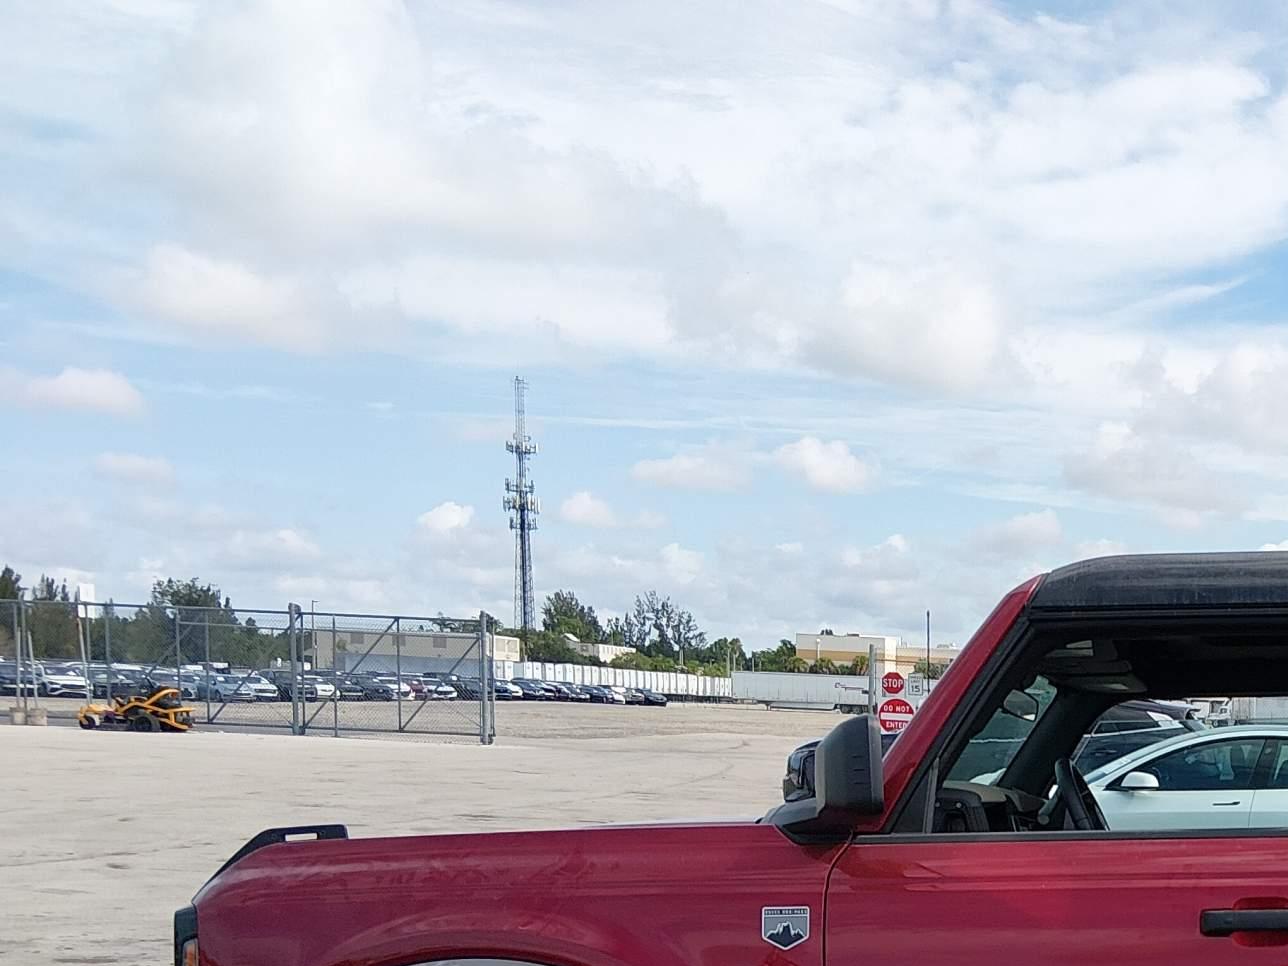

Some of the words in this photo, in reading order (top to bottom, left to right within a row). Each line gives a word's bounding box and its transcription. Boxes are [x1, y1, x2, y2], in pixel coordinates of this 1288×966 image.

[883, 679, 903, 688] STOP
[883, 704, 893, 712] DO
[895, 705, 910, 713] NOT
